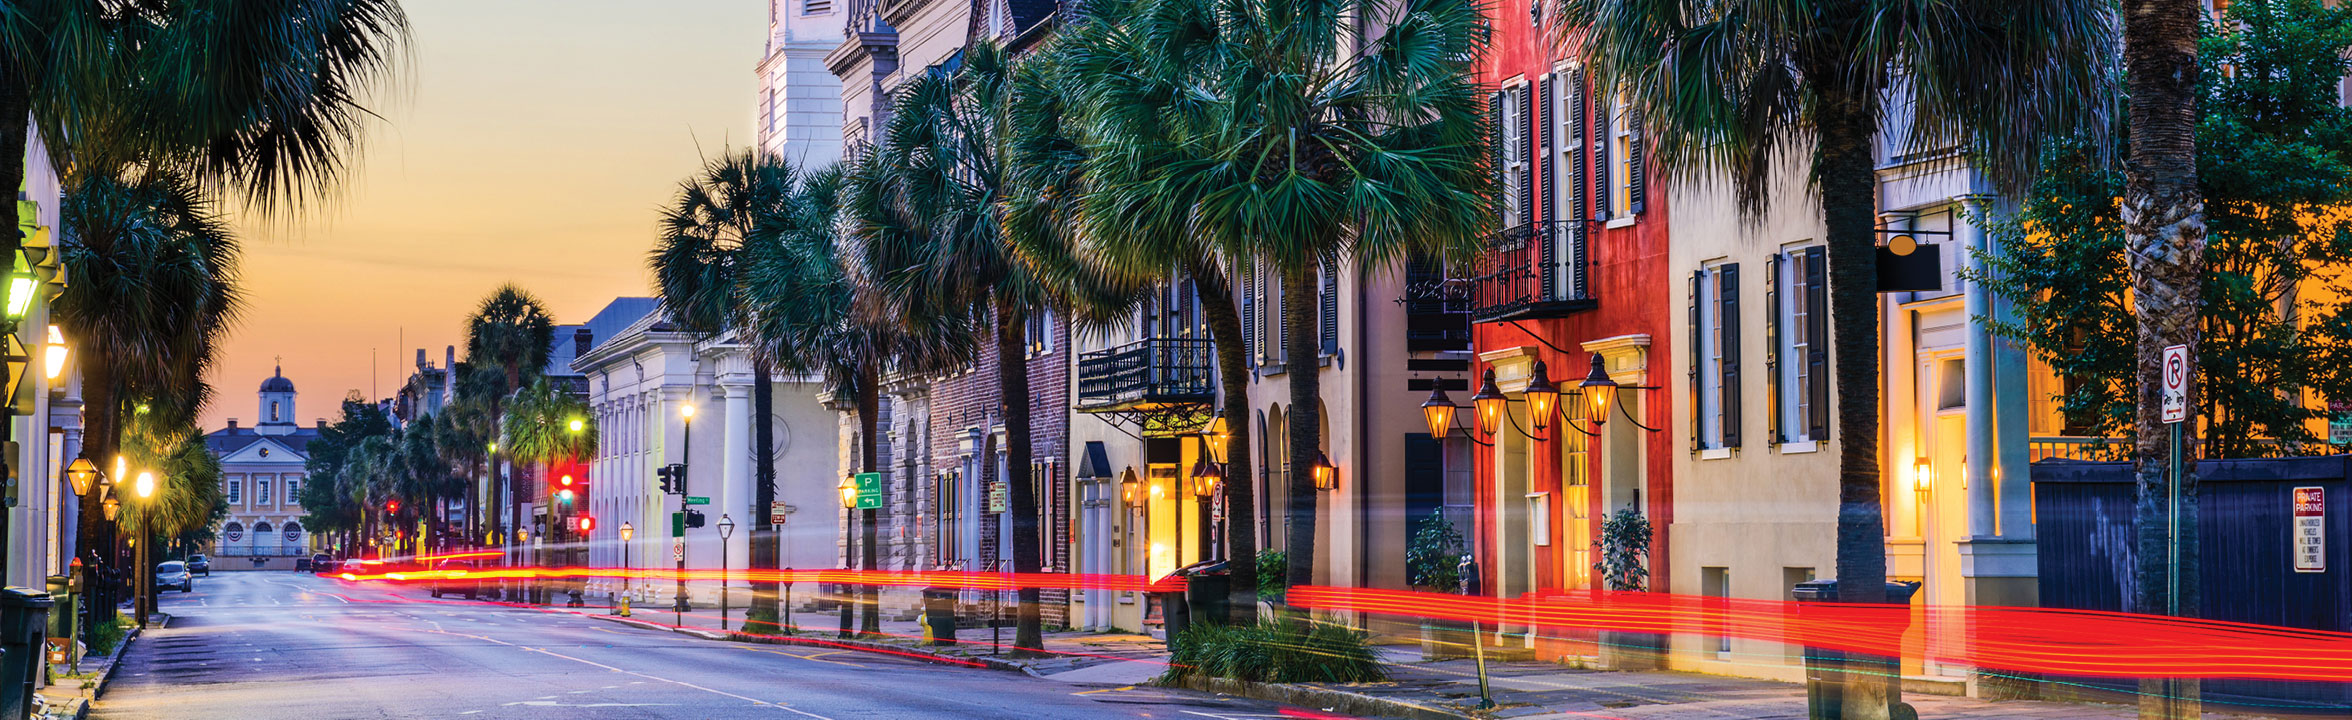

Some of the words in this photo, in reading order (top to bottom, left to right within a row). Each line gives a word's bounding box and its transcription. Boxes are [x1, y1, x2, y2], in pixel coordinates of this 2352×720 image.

[865, 477, 873, 487] P
[2297, 492, 2321, 502] PRIVATE
[2296, 503, 2322, 512] PARKING
